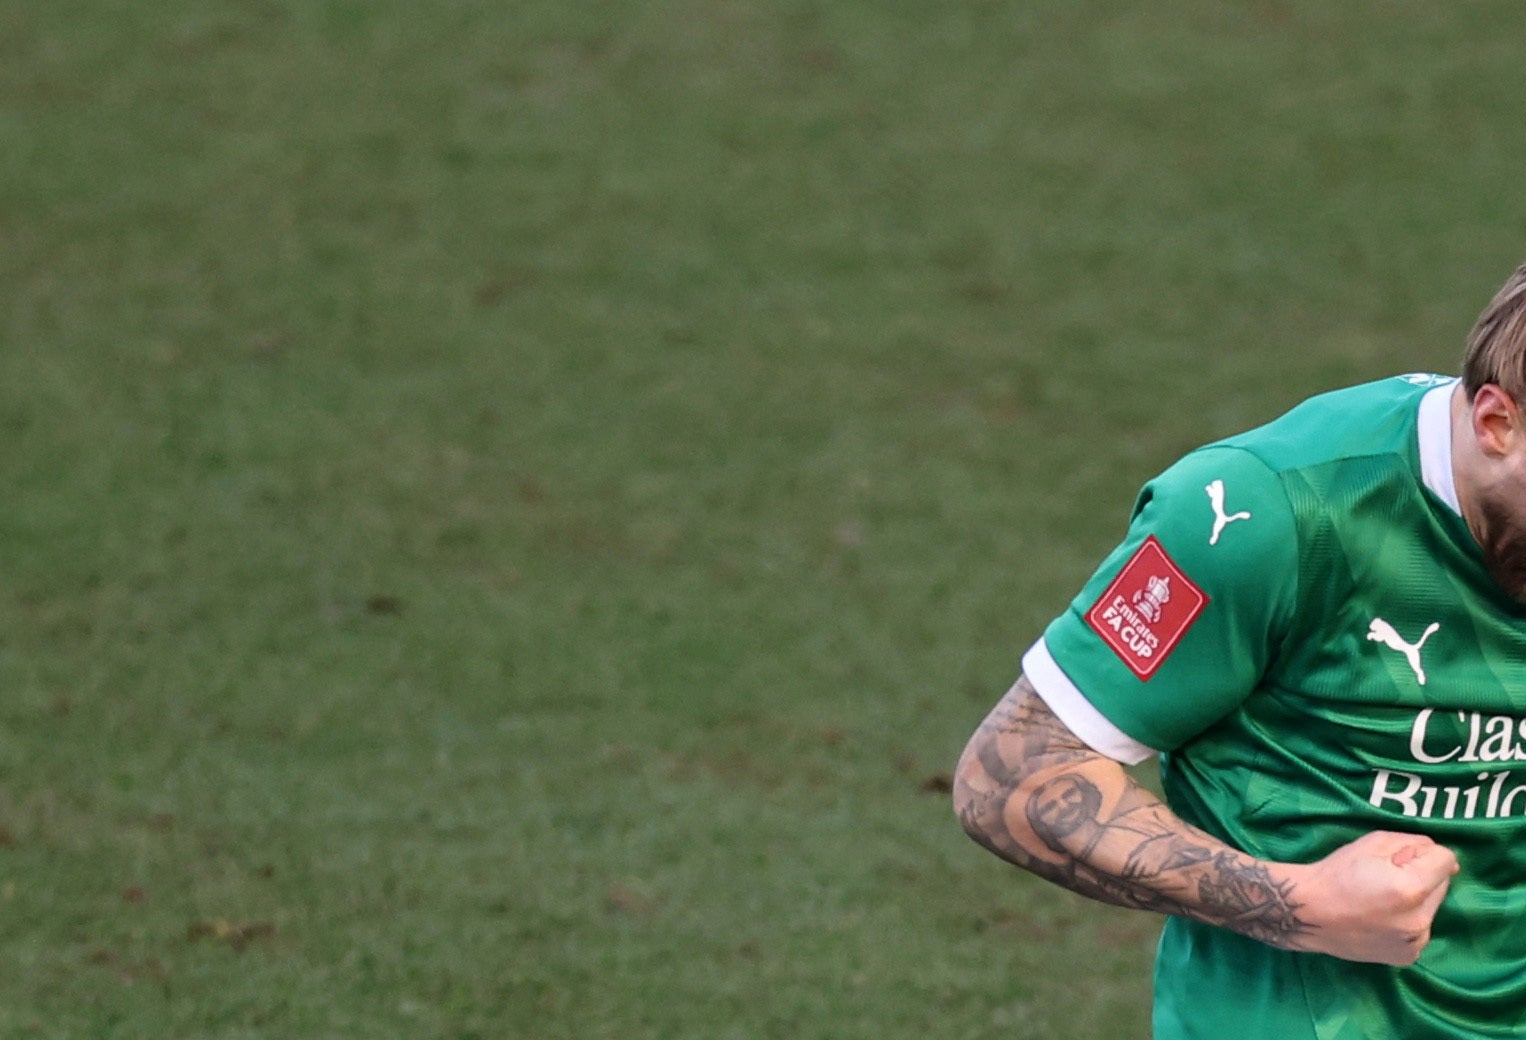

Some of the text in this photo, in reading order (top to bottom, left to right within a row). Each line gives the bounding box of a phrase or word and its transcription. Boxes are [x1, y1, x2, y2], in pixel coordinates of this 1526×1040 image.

[1102, 607, 1153, 658] FA CUP
[1112, 595, 1160, 649] Emirates
